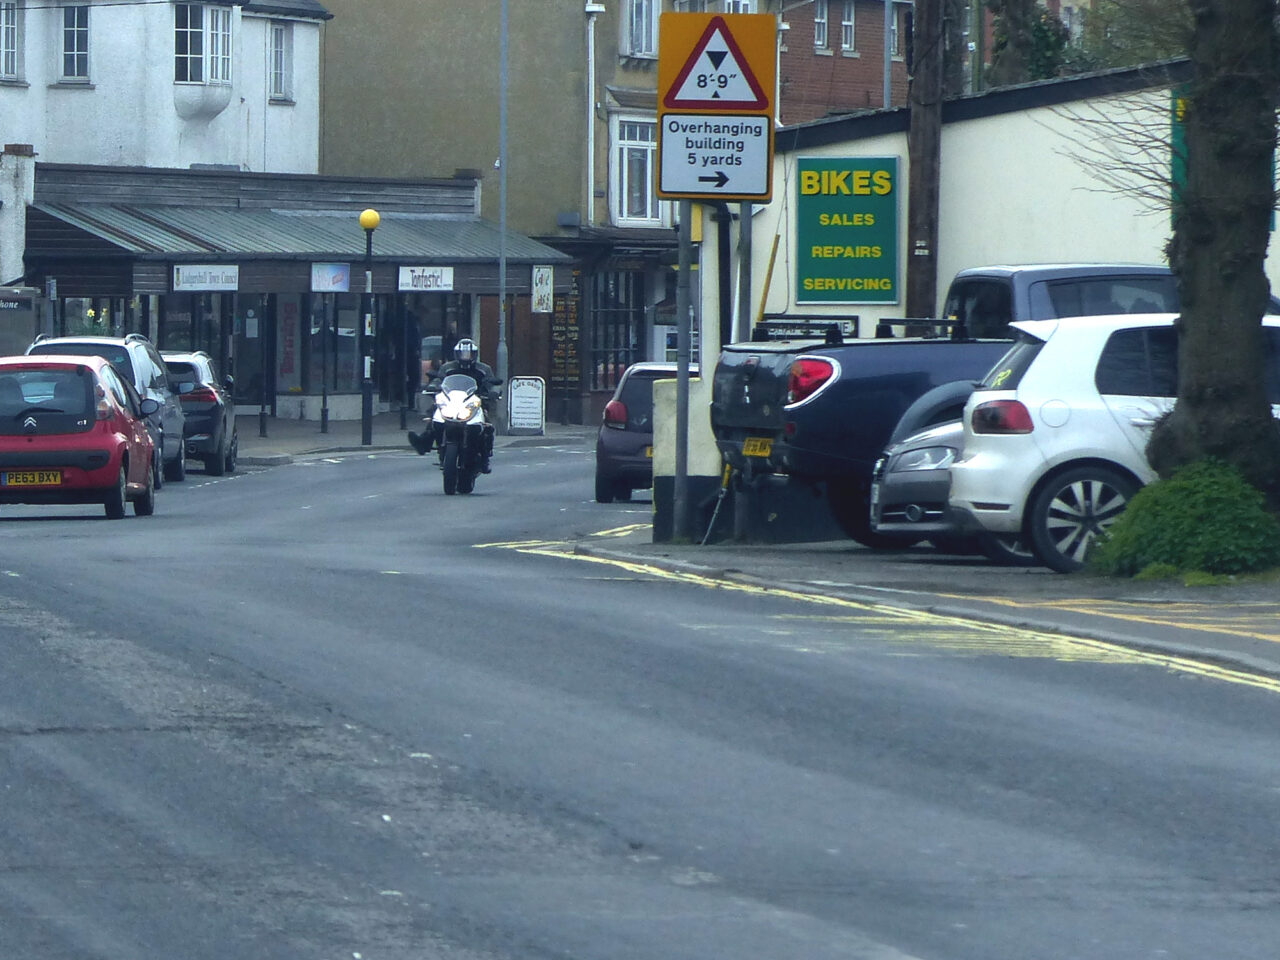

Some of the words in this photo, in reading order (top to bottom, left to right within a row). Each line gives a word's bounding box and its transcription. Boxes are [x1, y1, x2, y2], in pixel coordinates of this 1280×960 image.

[668, 121, 762, 137] Overhanging
[685, 137, 744, 152] building
[688, 153, 697, 165] 5
[702, 154, 742, 167] yards
[801, 170, 892, 196] BIKES
[819, 213, 875, 226] SALES
[811, 245, 882, 258] REPAIRS
[410, 268, 443, 288] Tanfastic!
[803, 278, 892, 290] SERVICING
[8, 472, 35, 483] PE63
[38, 471, 59, 483] BXY
